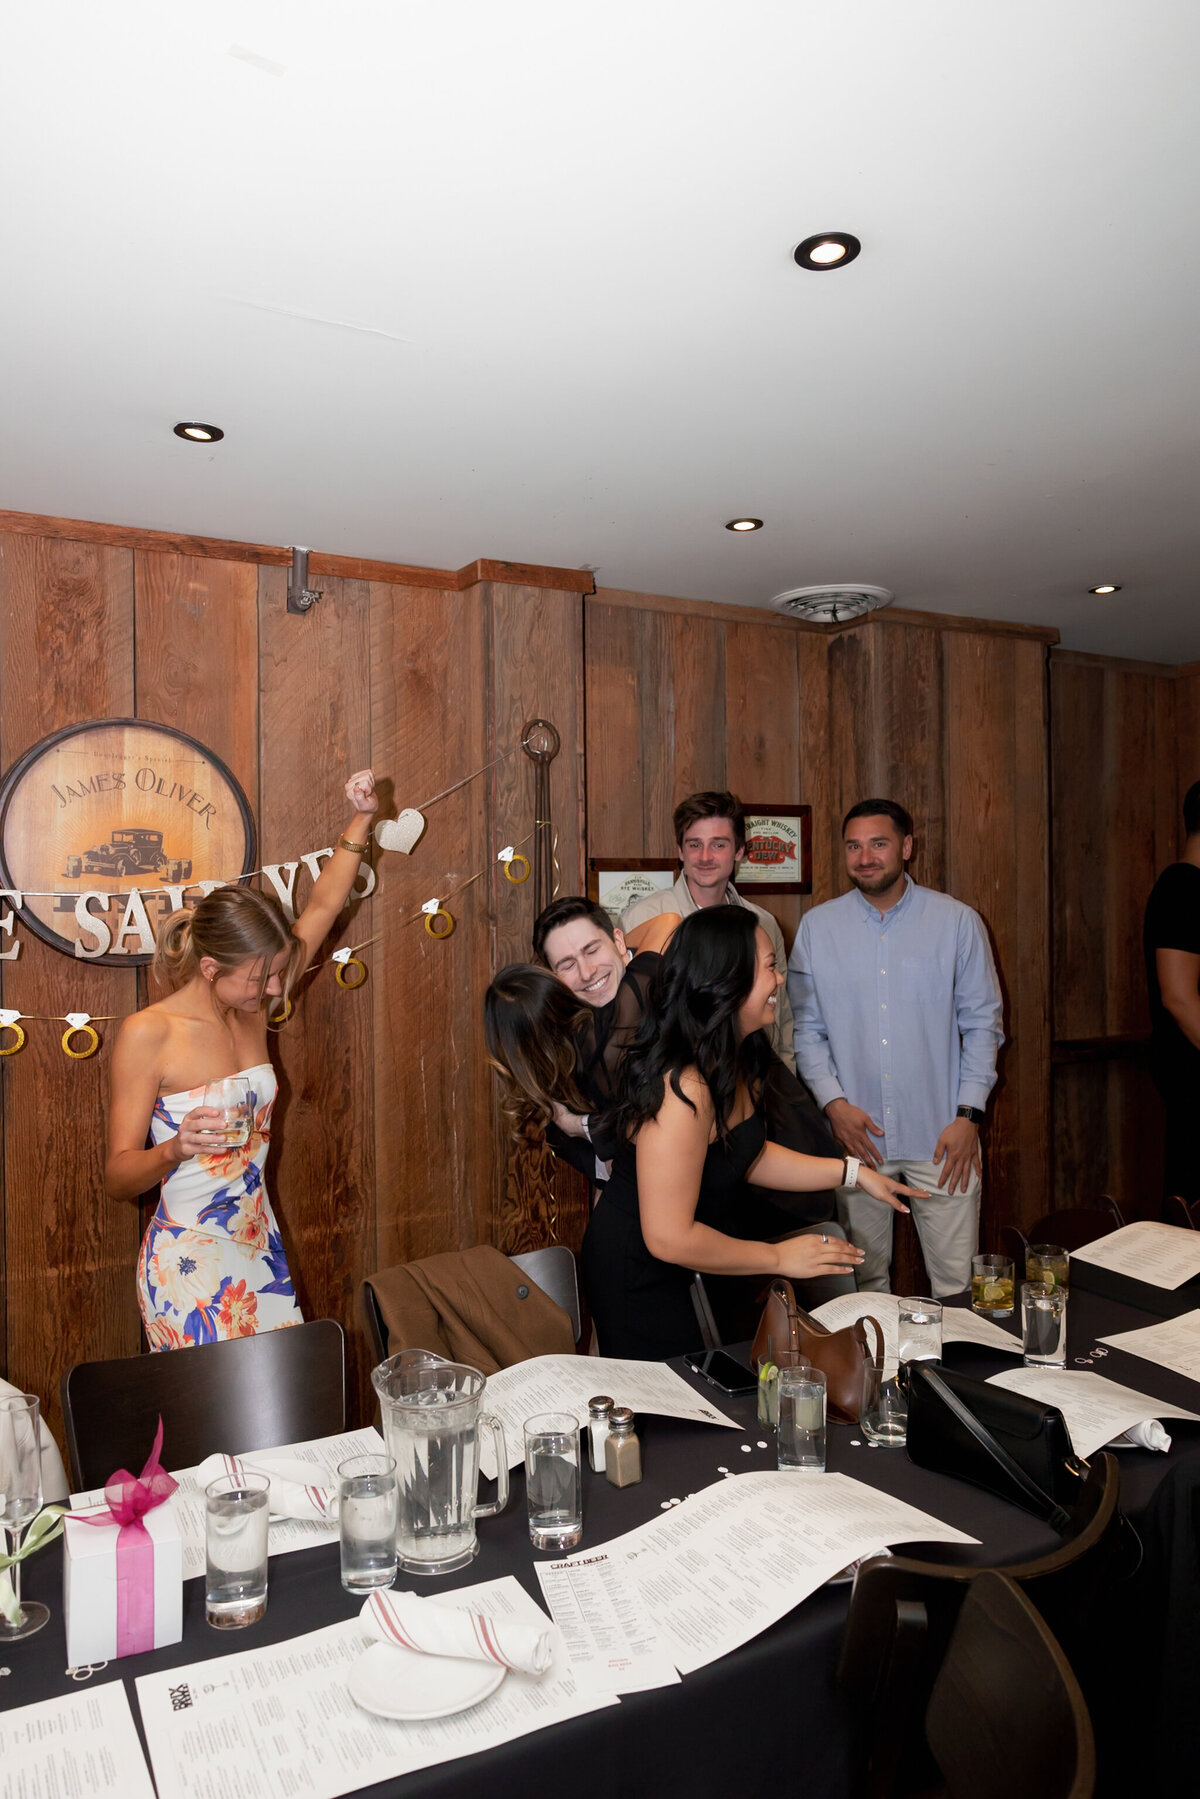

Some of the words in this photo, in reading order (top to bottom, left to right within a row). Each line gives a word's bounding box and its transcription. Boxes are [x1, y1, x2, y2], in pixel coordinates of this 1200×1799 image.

[51, 772, 127, 808] JAMES
[135, 767, 217, 830] OLIVER
[745, 819, 769, 831] RAIGHT
[771, 820, 797, 838] WHISKEY
[747, 840, 793, 853] ENTUCKY
[755, 851, 778, 861] DEW
[550, 1560, 582, 1570] CRAFT
[583, 1554, 609, 1565] BEER
